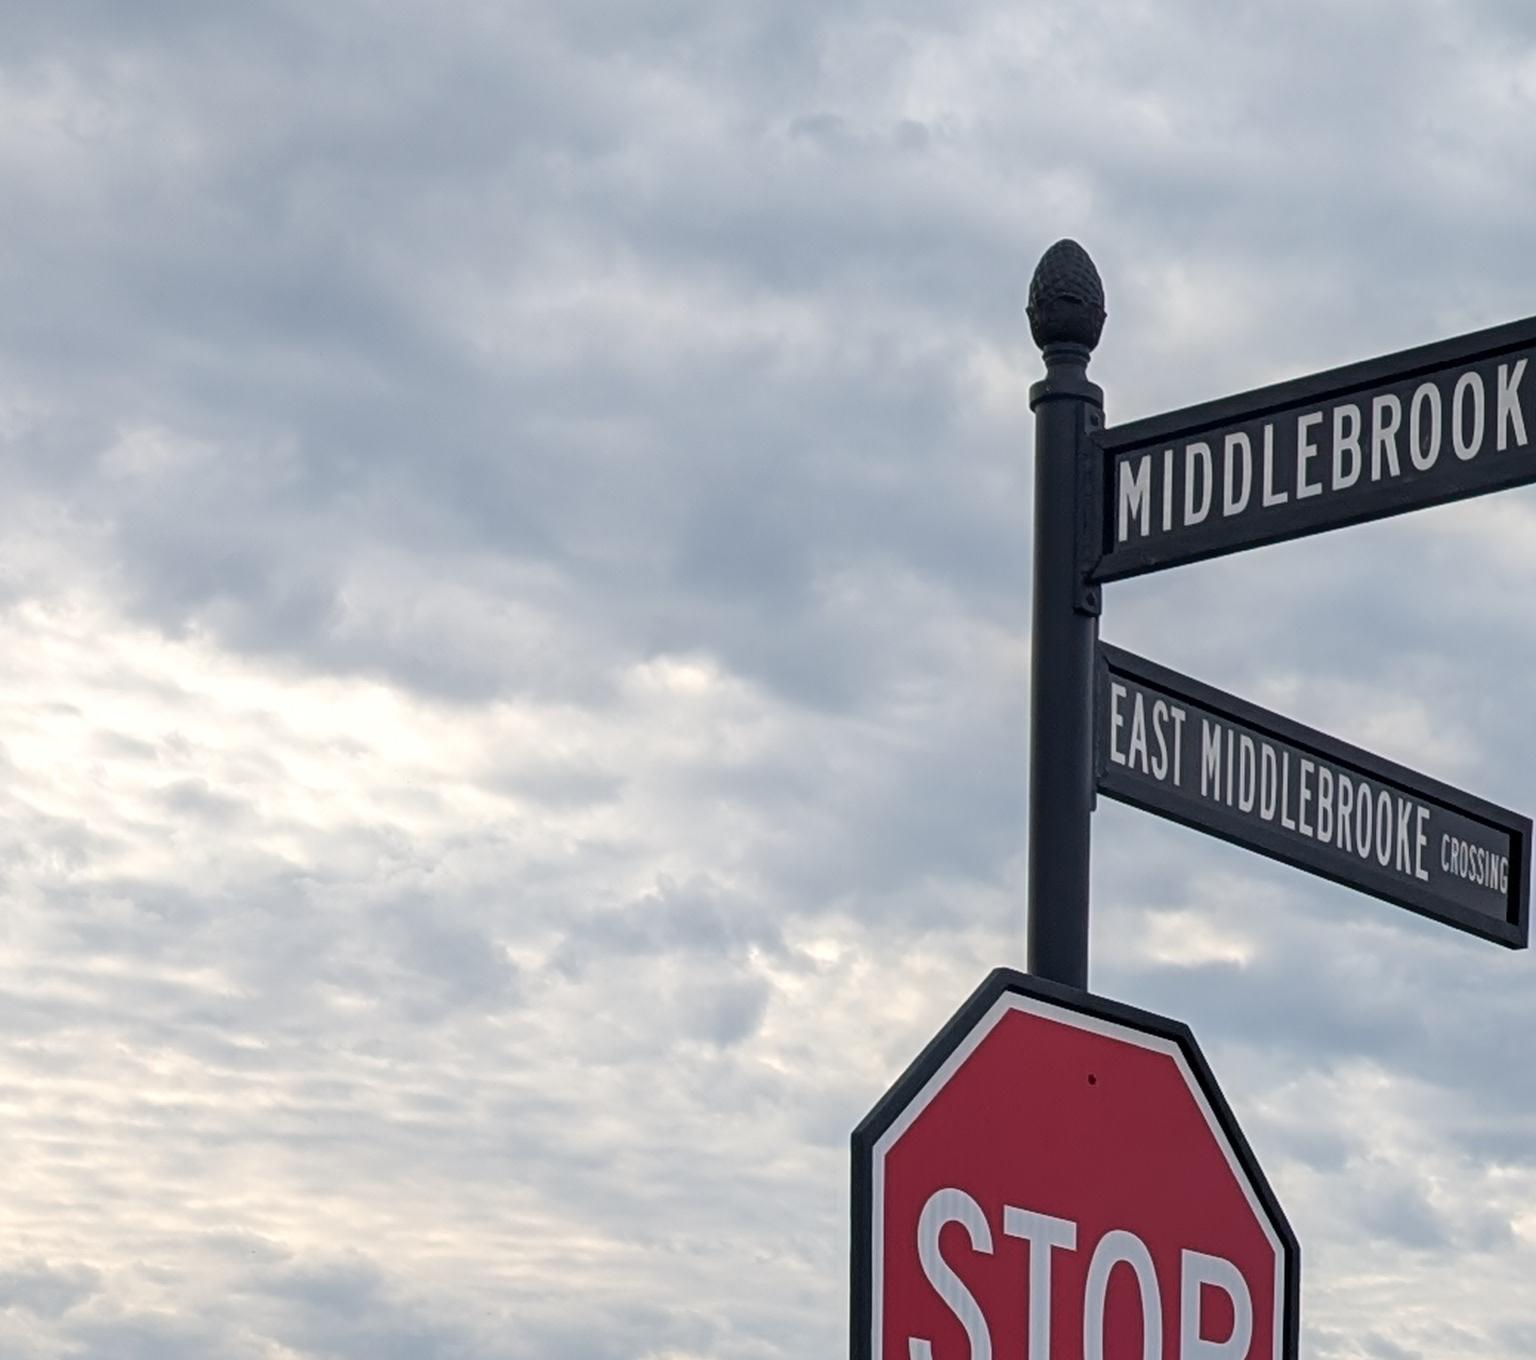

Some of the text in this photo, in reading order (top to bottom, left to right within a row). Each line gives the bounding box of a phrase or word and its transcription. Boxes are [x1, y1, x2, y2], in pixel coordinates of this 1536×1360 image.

[1109, 681, 1509, 895] EAST MIDDLEBROOKE CROSSING
